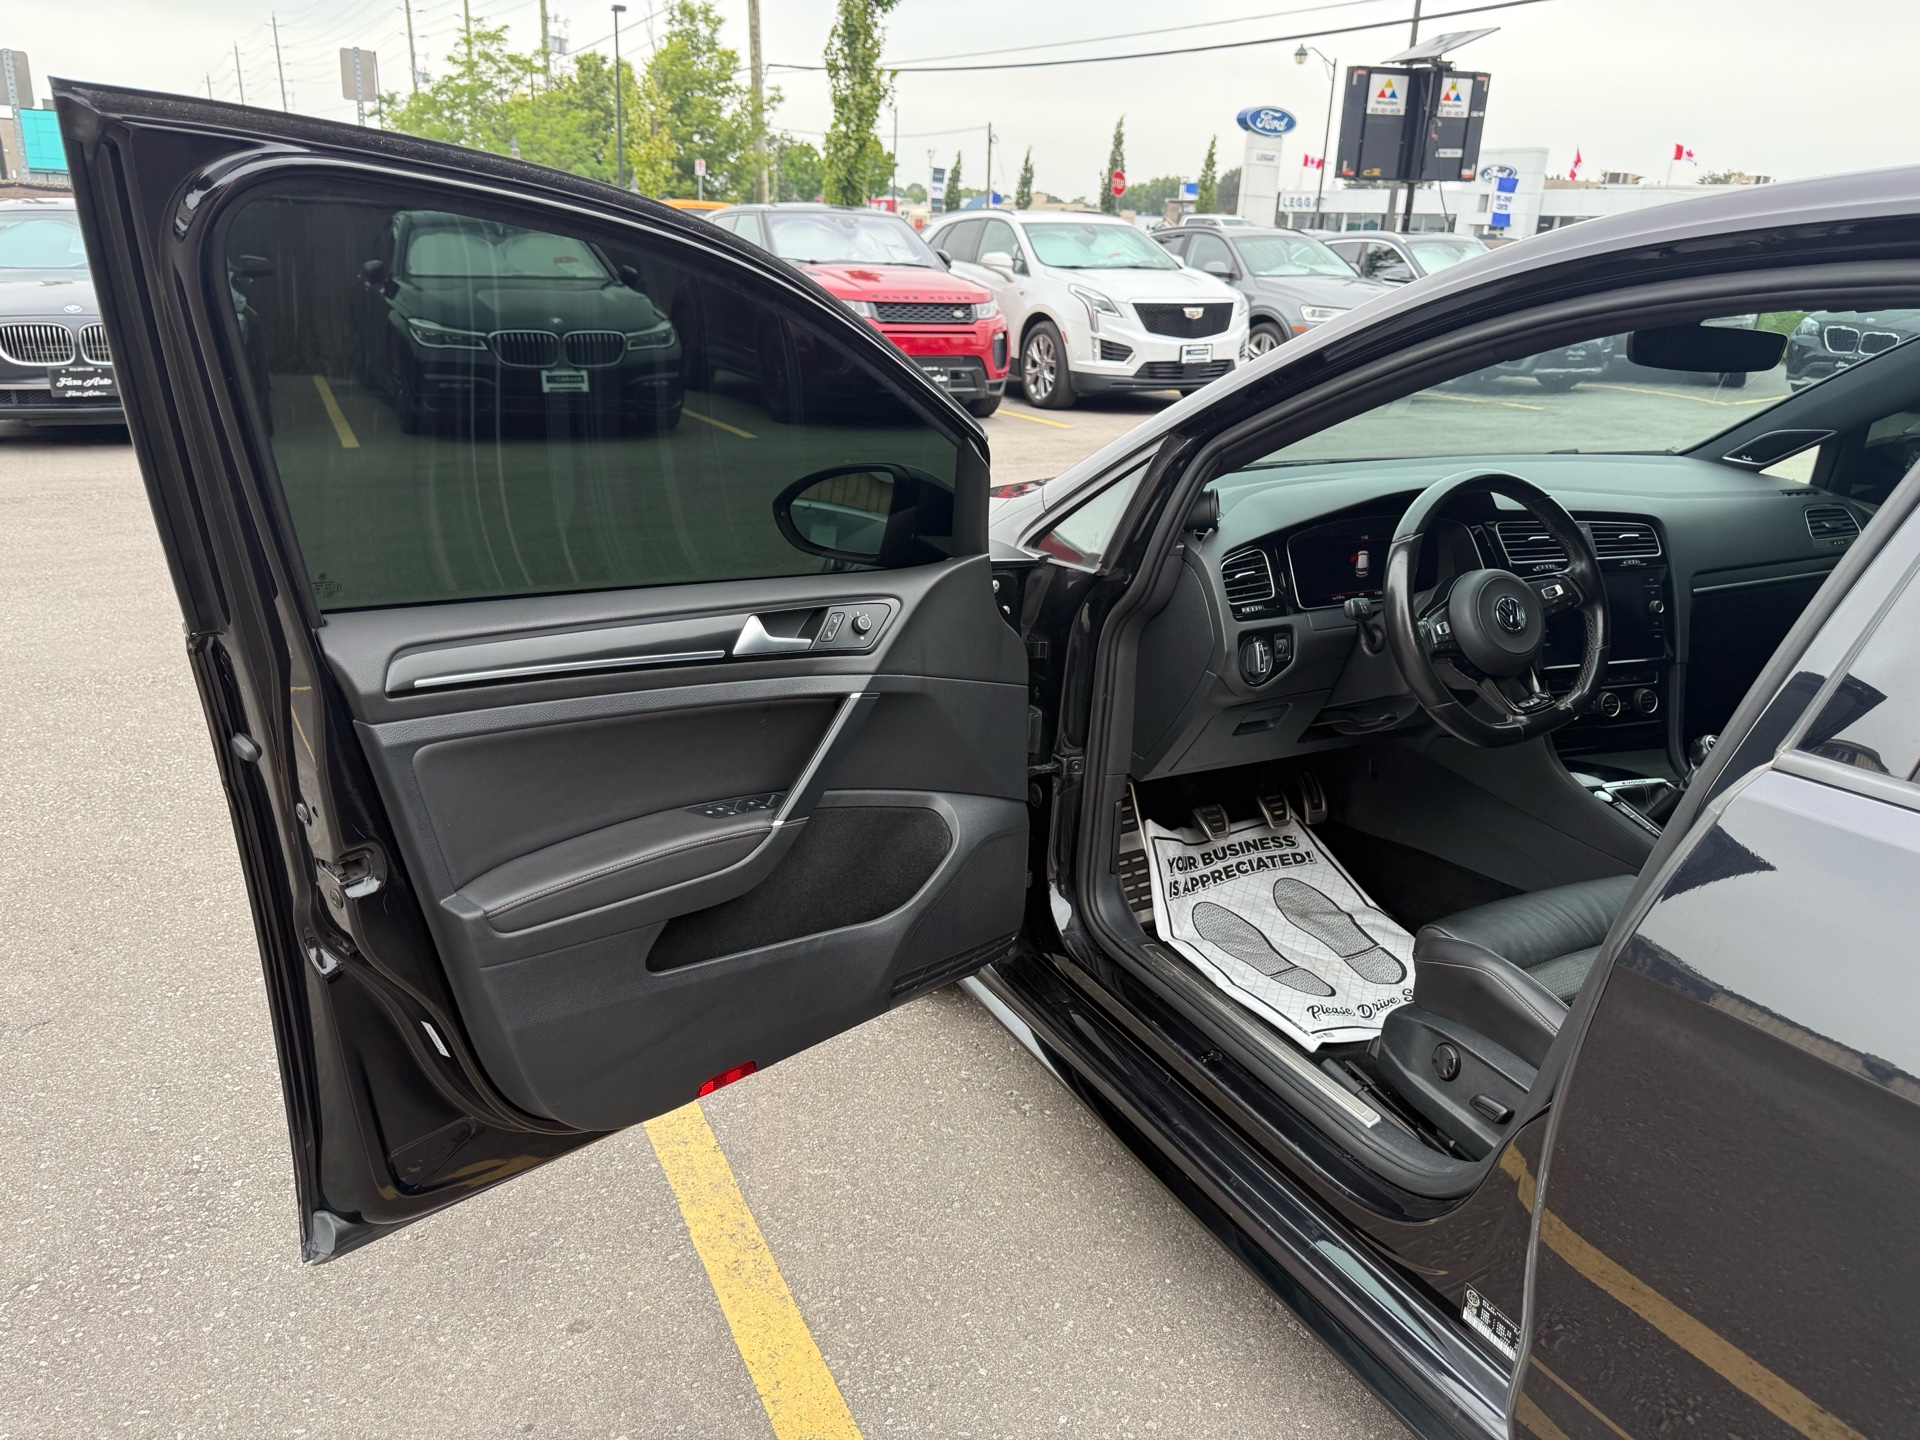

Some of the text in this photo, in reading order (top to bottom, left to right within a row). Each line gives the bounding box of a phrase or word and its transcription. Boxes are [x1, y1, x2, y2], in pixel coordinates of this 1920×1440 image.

[1256, 109, 1289, 132] Ford
[1112, 178, 1125, 189] STOP
[1167, 835, 1298, 876] YOUR BUSINESS
[1168, 851, 1317, 899] IS APPRECIATED!
[1306, 996, 1400, 1020] Please Drive
